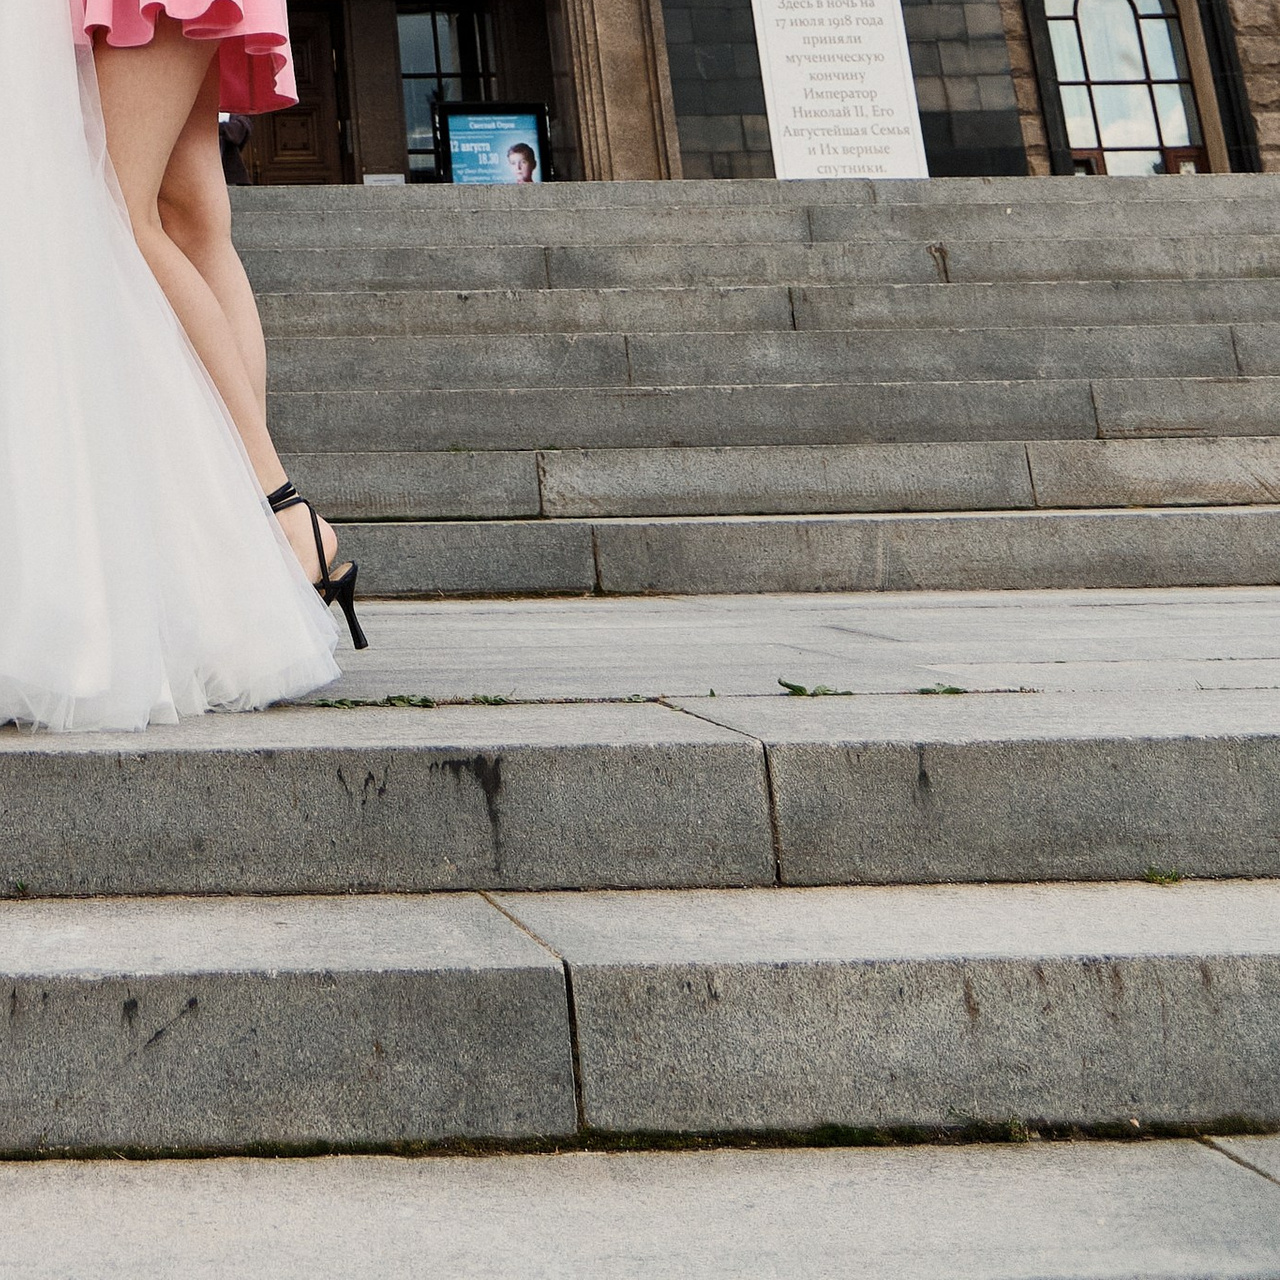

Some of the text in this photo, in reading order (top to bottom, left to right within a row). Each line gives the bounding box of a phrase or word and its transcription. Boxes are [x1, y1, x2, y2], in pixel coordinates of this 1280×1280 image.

[817, 0, 824, 9] в
[827, 0, 858, 9] ночь
[775, 15, 885, 30] 17 июля 1918 года
[803, 34, 863, 48] приняли
[785, 52, 885, 67] мученическую
[809, 71, 866, 83] кончину
[804, 87, 878, 102] Император
[792, 105, 851, 119] Николай
[872, 103, 895, 118] Его
[783, 123, 910, 140] Августейшая Семья
[808, 142, 891, 158] и Их верные
[817, 163, 888, 177] спутники.
